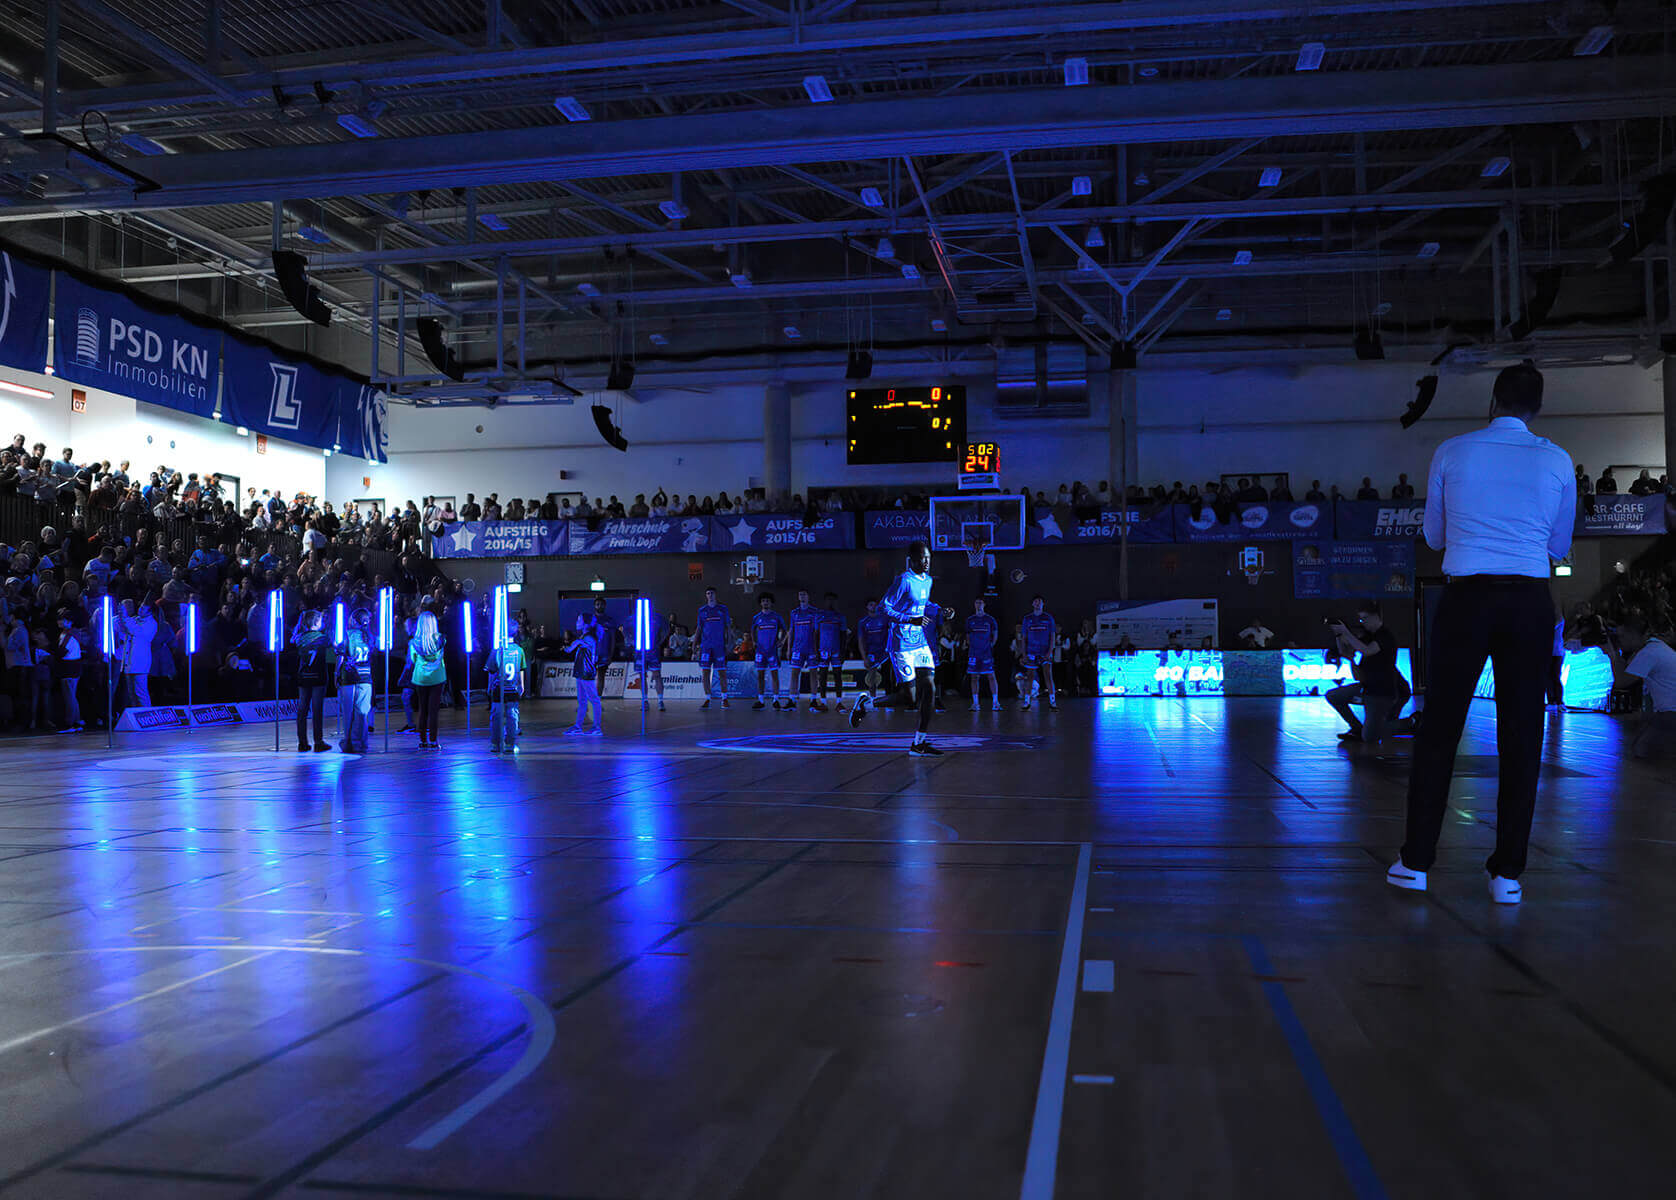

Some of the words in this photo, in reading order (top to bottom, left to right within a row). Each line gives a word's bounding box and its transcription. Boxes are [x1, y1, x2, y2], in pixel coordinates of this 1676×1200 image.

[109, 318, 163, 364] PSD
[172, 339, 208, 381] KN
[107, 353, 207, 400] Immobilien
[931, 387, 942, 401] 0
[75, 400, 85, 410] 07
[965, 456, 989, 472] 24
[484, 525, 548, 538] AUFSTIEG
[603, 520, 671, 535] Fahrschule
[609, 536, 635, 548] Frank
[637, 535, 661, 549] Dopf
[766, 530, 816, 544] 2015/16
[484, 538, 532, 551] 2014/15
[505, 662, 515, 681] 9
